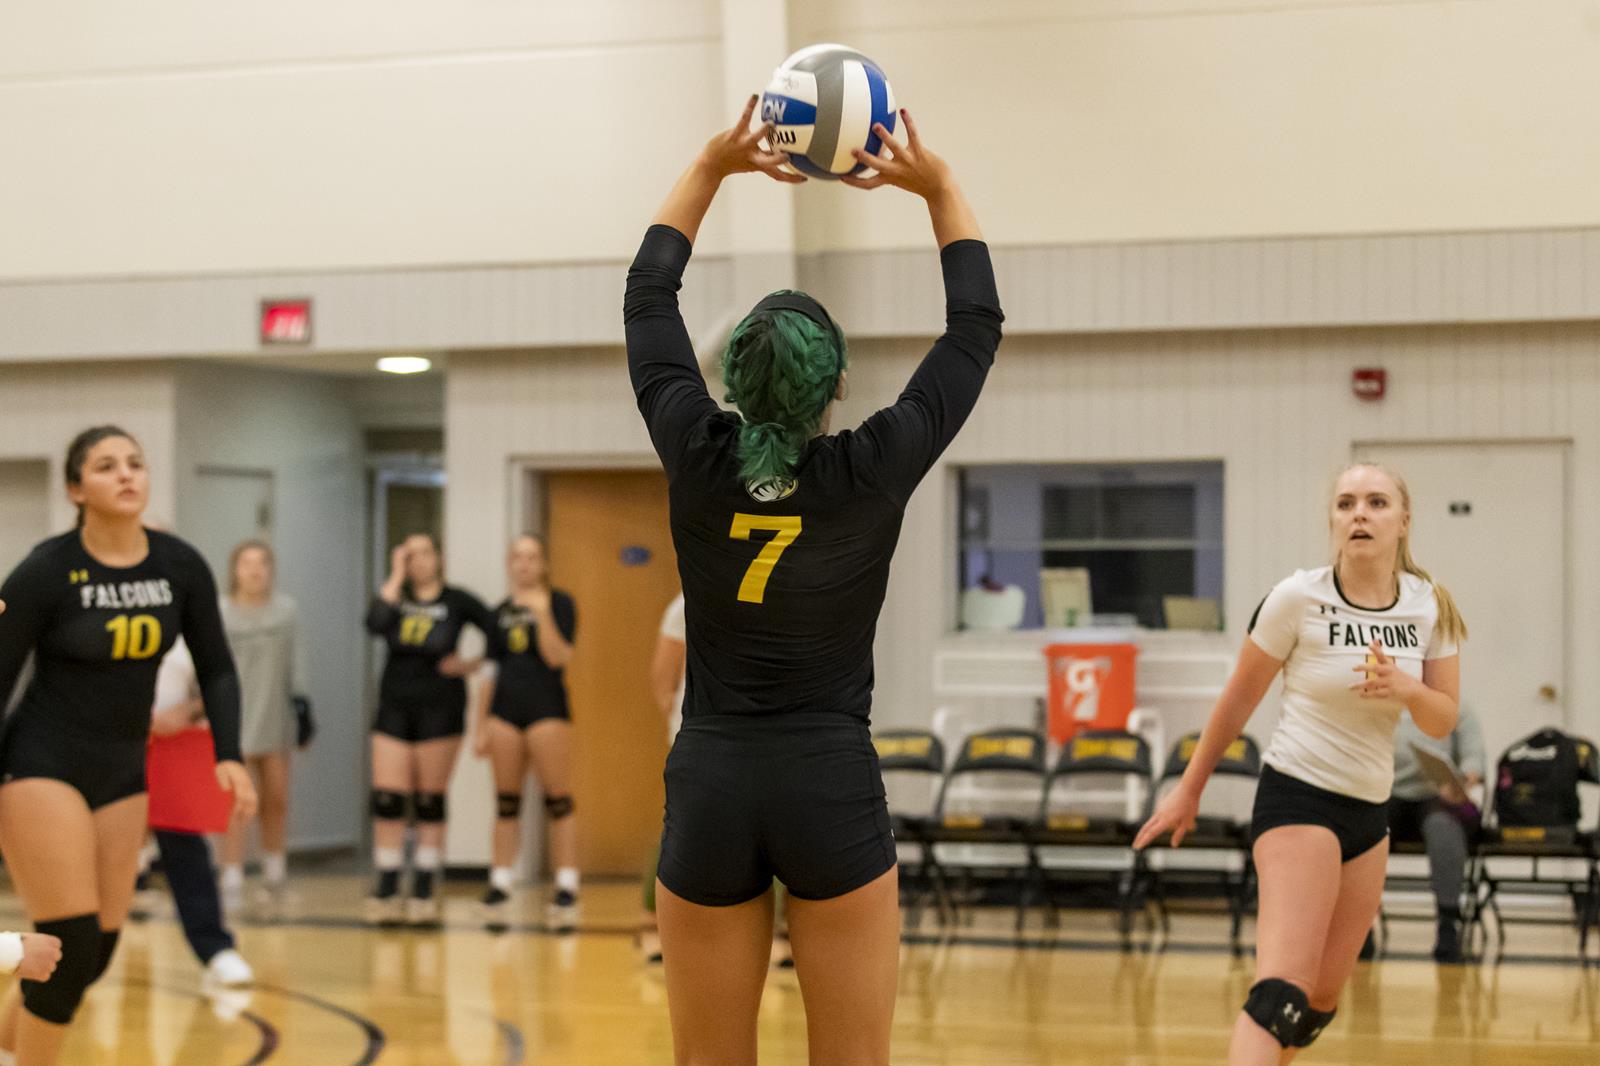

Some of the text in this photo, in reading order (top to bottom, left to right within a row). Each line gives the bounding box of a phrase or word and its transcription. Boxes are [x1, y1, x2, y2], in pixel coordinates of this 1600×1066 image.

[729, 512, 802, 604] 7
[81, 579, 173, 608] FALCONS
[105, 614, 162, 660] 10
[1329, 622, 1418, 648] FALCONS
